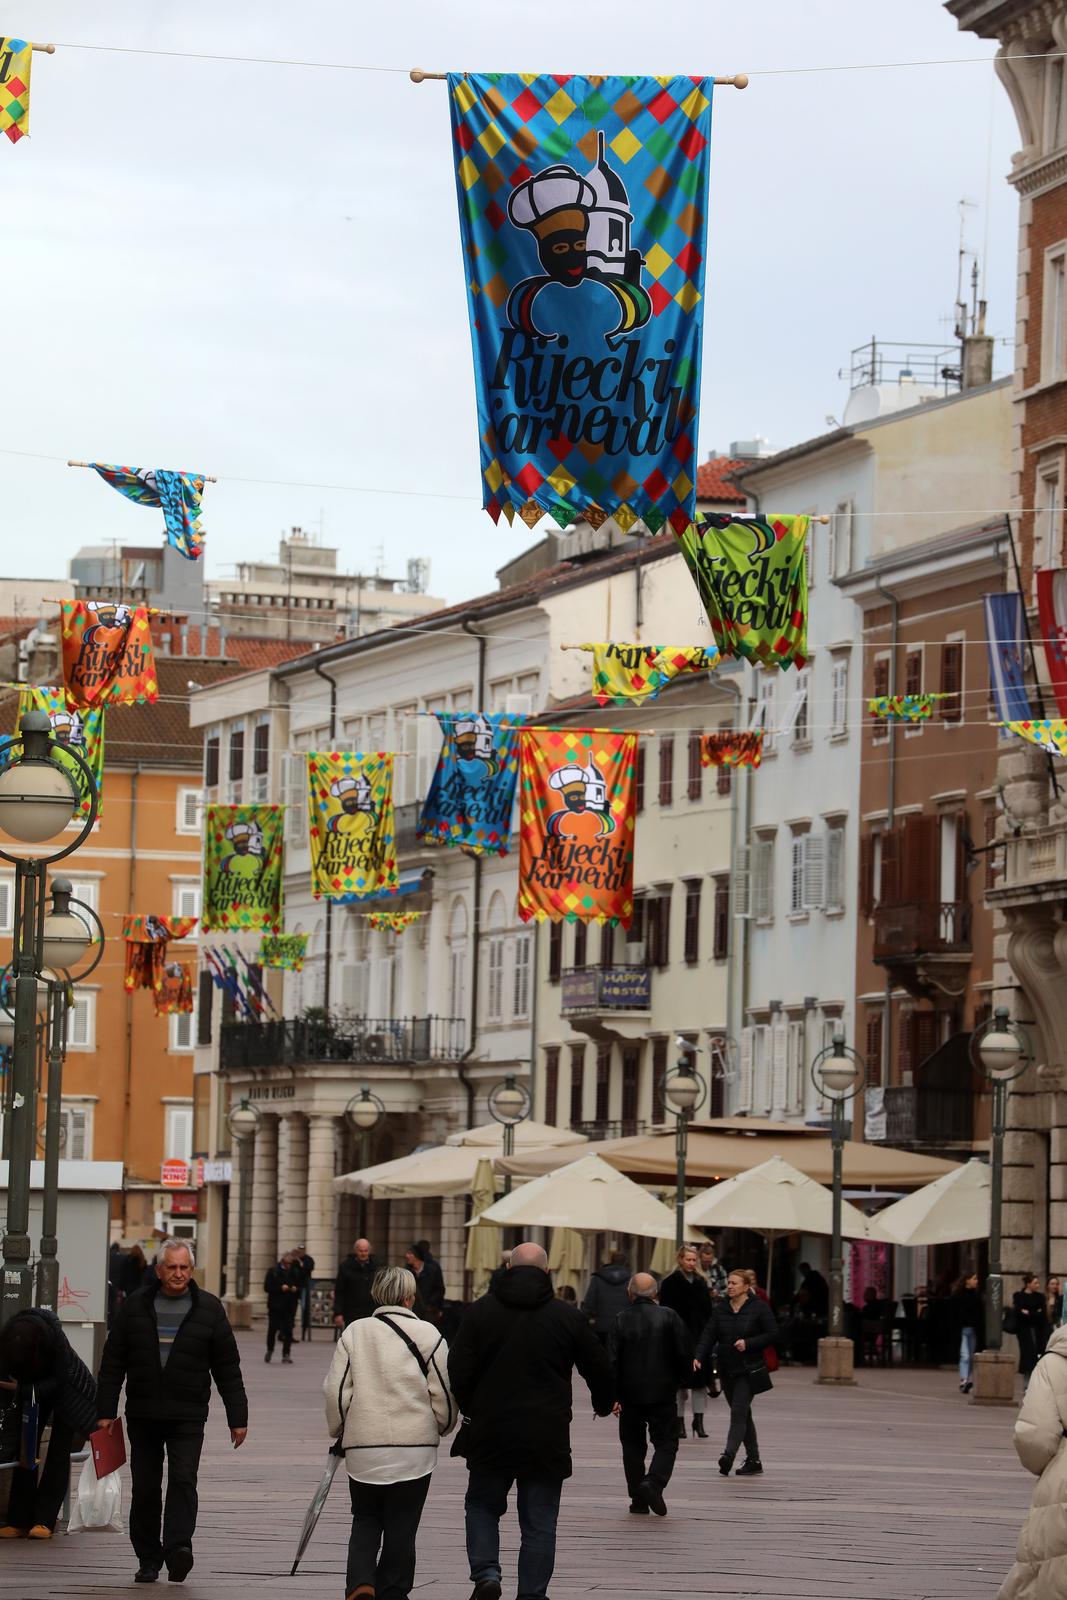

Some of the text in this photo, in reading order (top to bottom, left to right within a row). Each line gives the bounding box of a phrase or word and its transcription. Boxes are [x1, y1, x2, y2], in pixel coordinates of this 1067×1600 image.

[494, 385, 683, 457] arneval
[527, 855, 629, 892] karneval
[604, 974, 647, 983] HAPPY
[602, 986, 649, 996] HOSTEL
